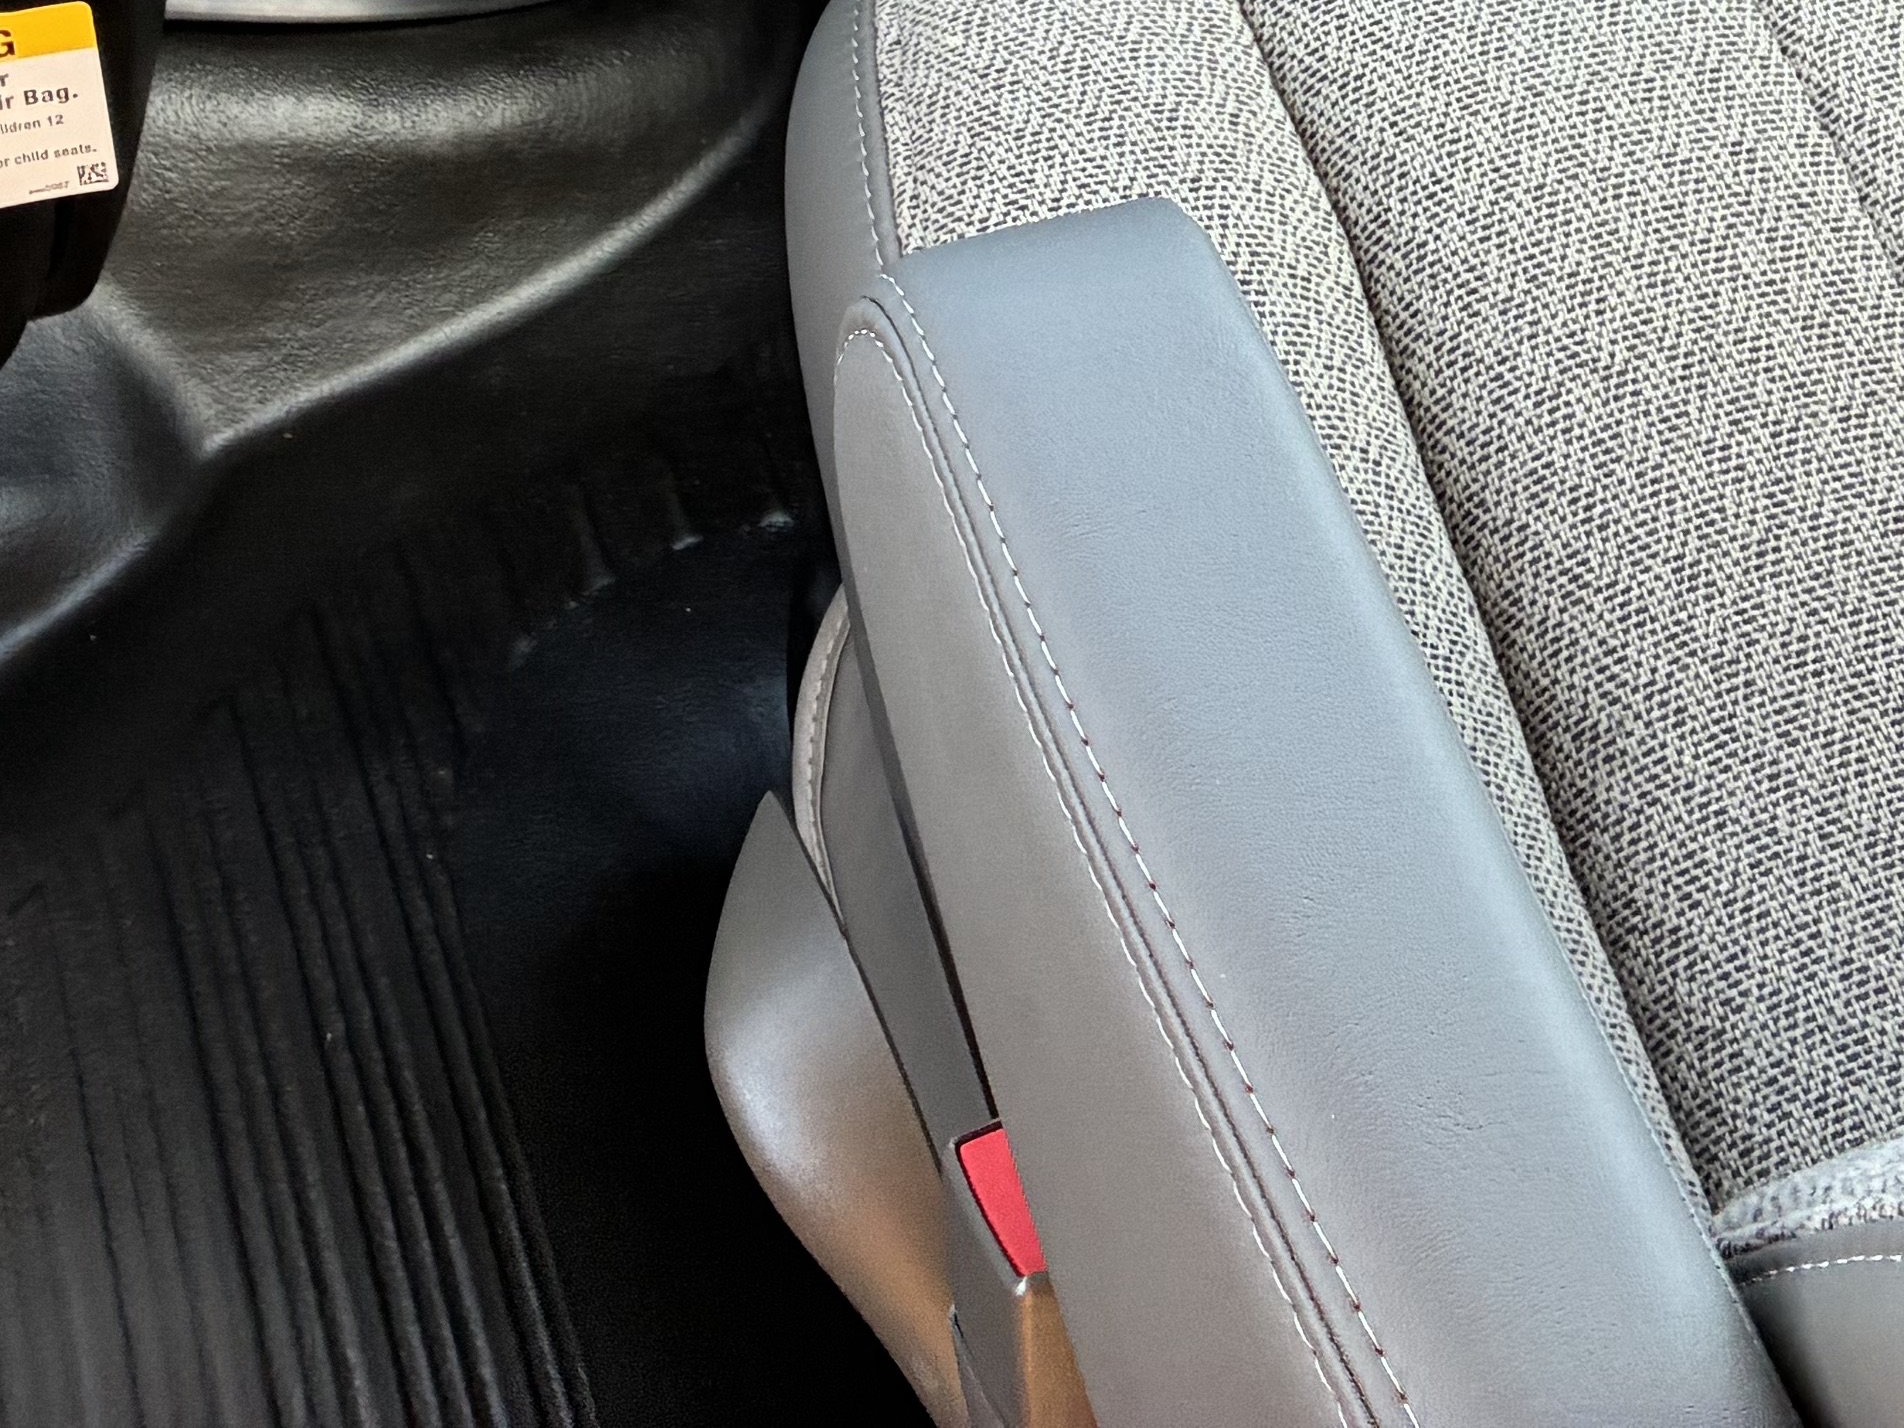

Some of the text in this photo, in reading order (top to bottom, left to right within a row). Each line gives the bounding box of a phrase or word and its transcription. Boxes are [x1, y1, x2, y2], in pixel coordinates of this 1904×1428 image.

[23, 86, 79, 106] Bag.
[47, 114, 65, 127] 12
[14, 149, 50, 166] child
[53, 144, 98, 158] seats.
